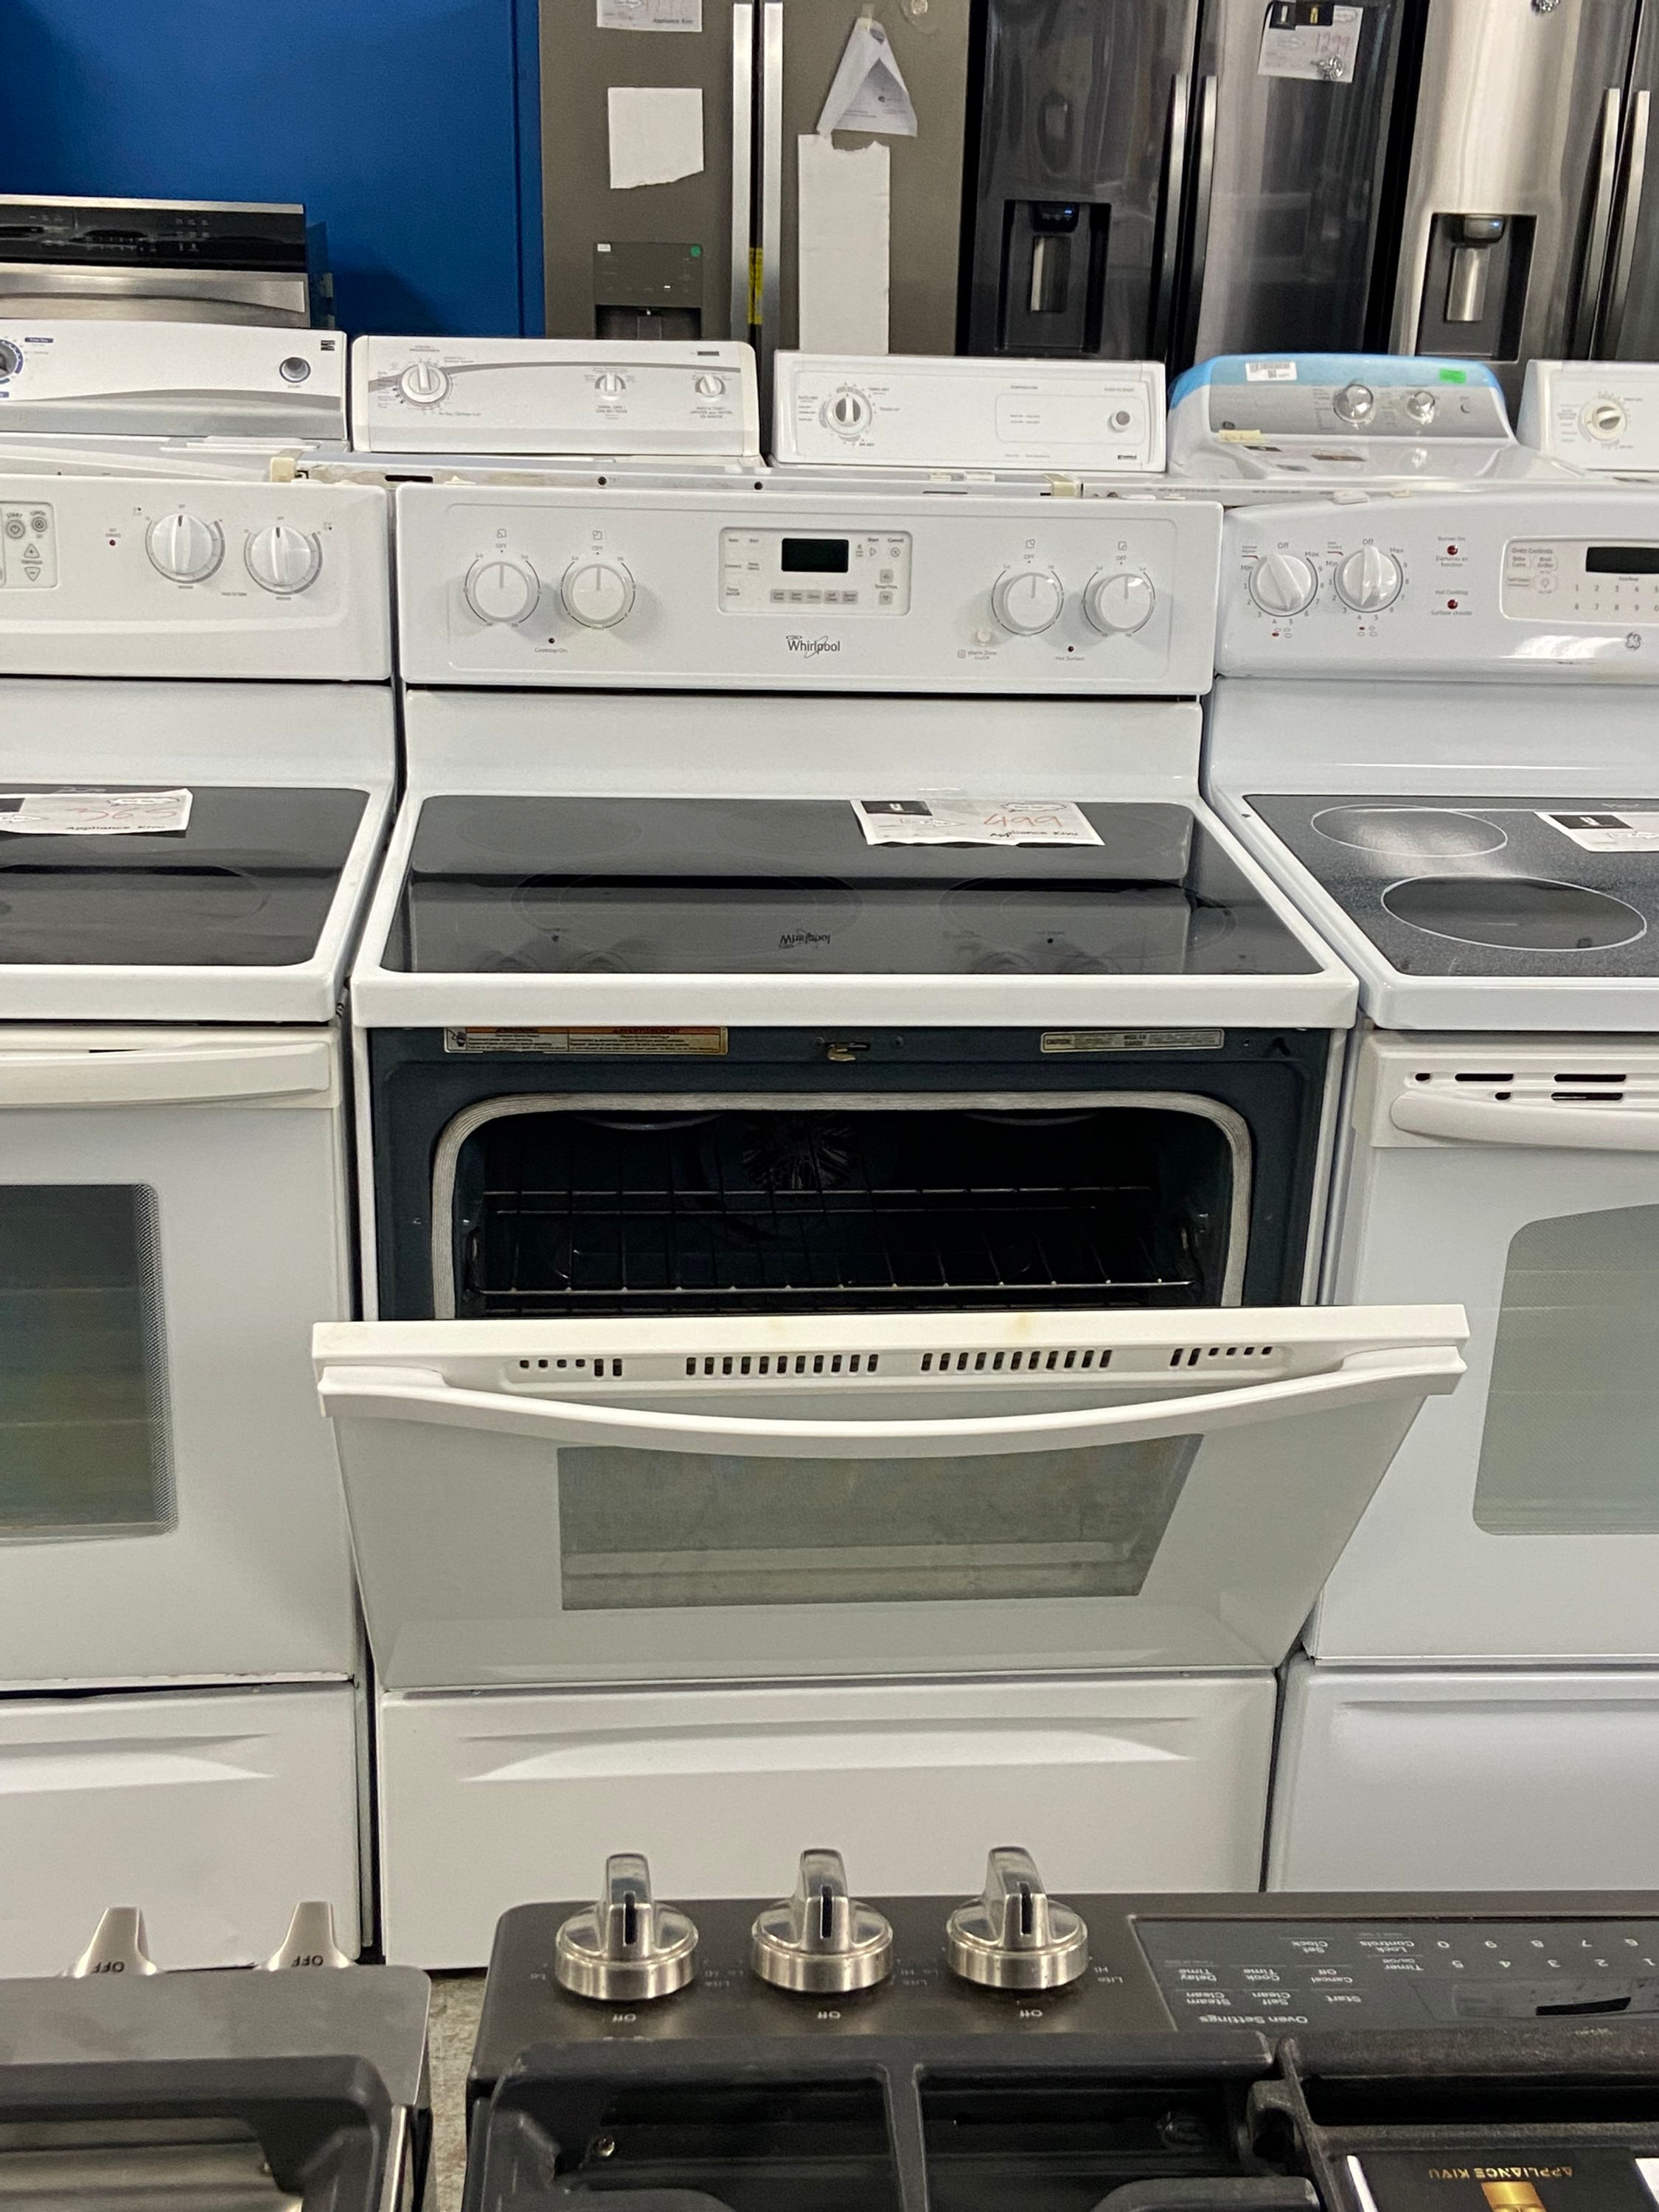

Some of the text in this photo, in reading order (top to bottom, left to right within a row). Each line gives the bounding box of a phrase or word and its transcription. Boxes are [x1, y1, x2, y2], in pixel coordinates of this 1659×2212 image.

[787, 638, 840, 656] Whirlpool
[67, 807, 178, 821] 365
[983, 813, 1062, 827] 499
[990, 830, 1047, 838] Appliance
[1485, 1940, 1498, 1948] 9
[1531, 1940, 1544, 1948] 8
[1582, 1939, 1592, 1947] 7
[292, 1955, 323, 1967] OFF
[1452, 1960, 1464, 1968] 5
[1548, 1959, 1560, 1967] 3
[1595, 1958, 1608, 1966] 2
[1644, 1958, 1655, 1966] 1
[93, 1961, 125, 1973] OFF
[613, 2013, 637, 2022] Off
[817, 2011, 841, 2020] Off
[1019, 2009, 1043, 2018] Off
[1199, 2014, 1308, 2024] Oven Settings
[1427, 2166, 1574, 2179] APPLIANCE KIVU
